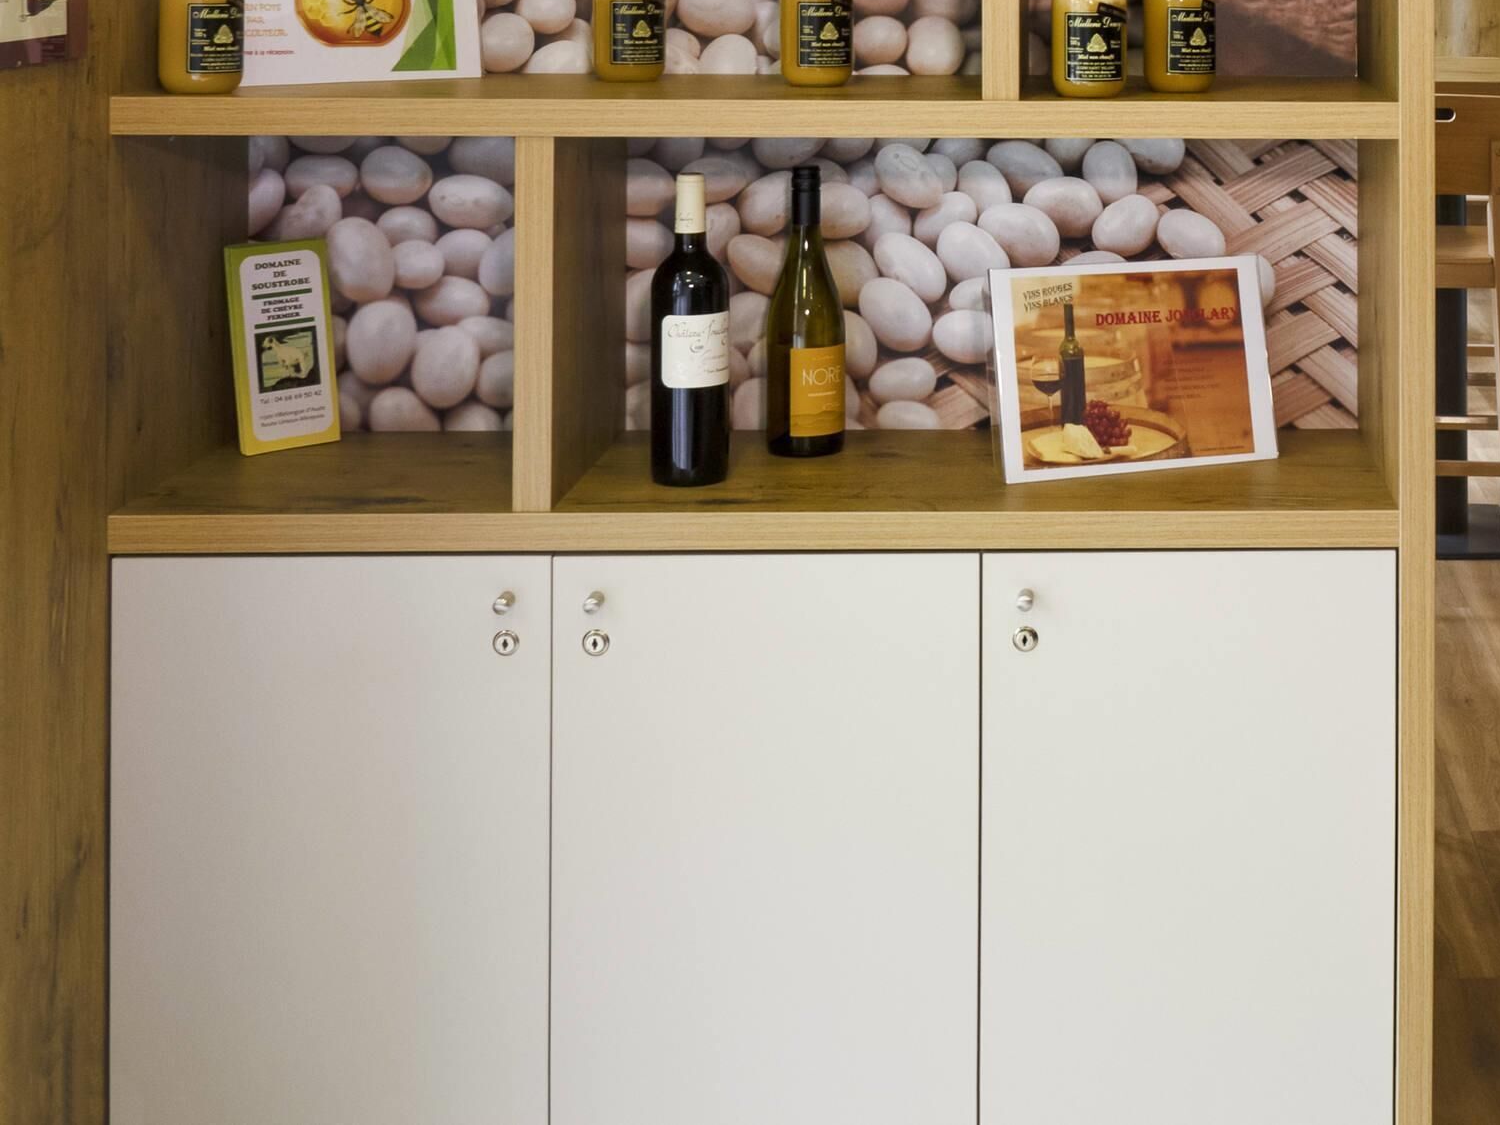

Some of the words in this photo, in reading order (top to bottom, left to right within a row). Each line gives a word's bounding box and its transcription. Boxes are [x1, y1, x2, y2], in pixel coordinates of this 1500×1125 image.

[254, 258, 302, 270] DOMAINE
[273, 270, 287, 278] DE
[251, 277, 311, 291] SOUSTROBE
[1022, 286, 1041, 302] VINS
[1041, 282, 1073, 297] ROUGES
[1023, 300, 1042, 314] VINS
[1043, 293, 1074, 308] BLANCS
[1095, 310, 1162, 327] DOMAINE
[802, 365, 841, 387] NORE
